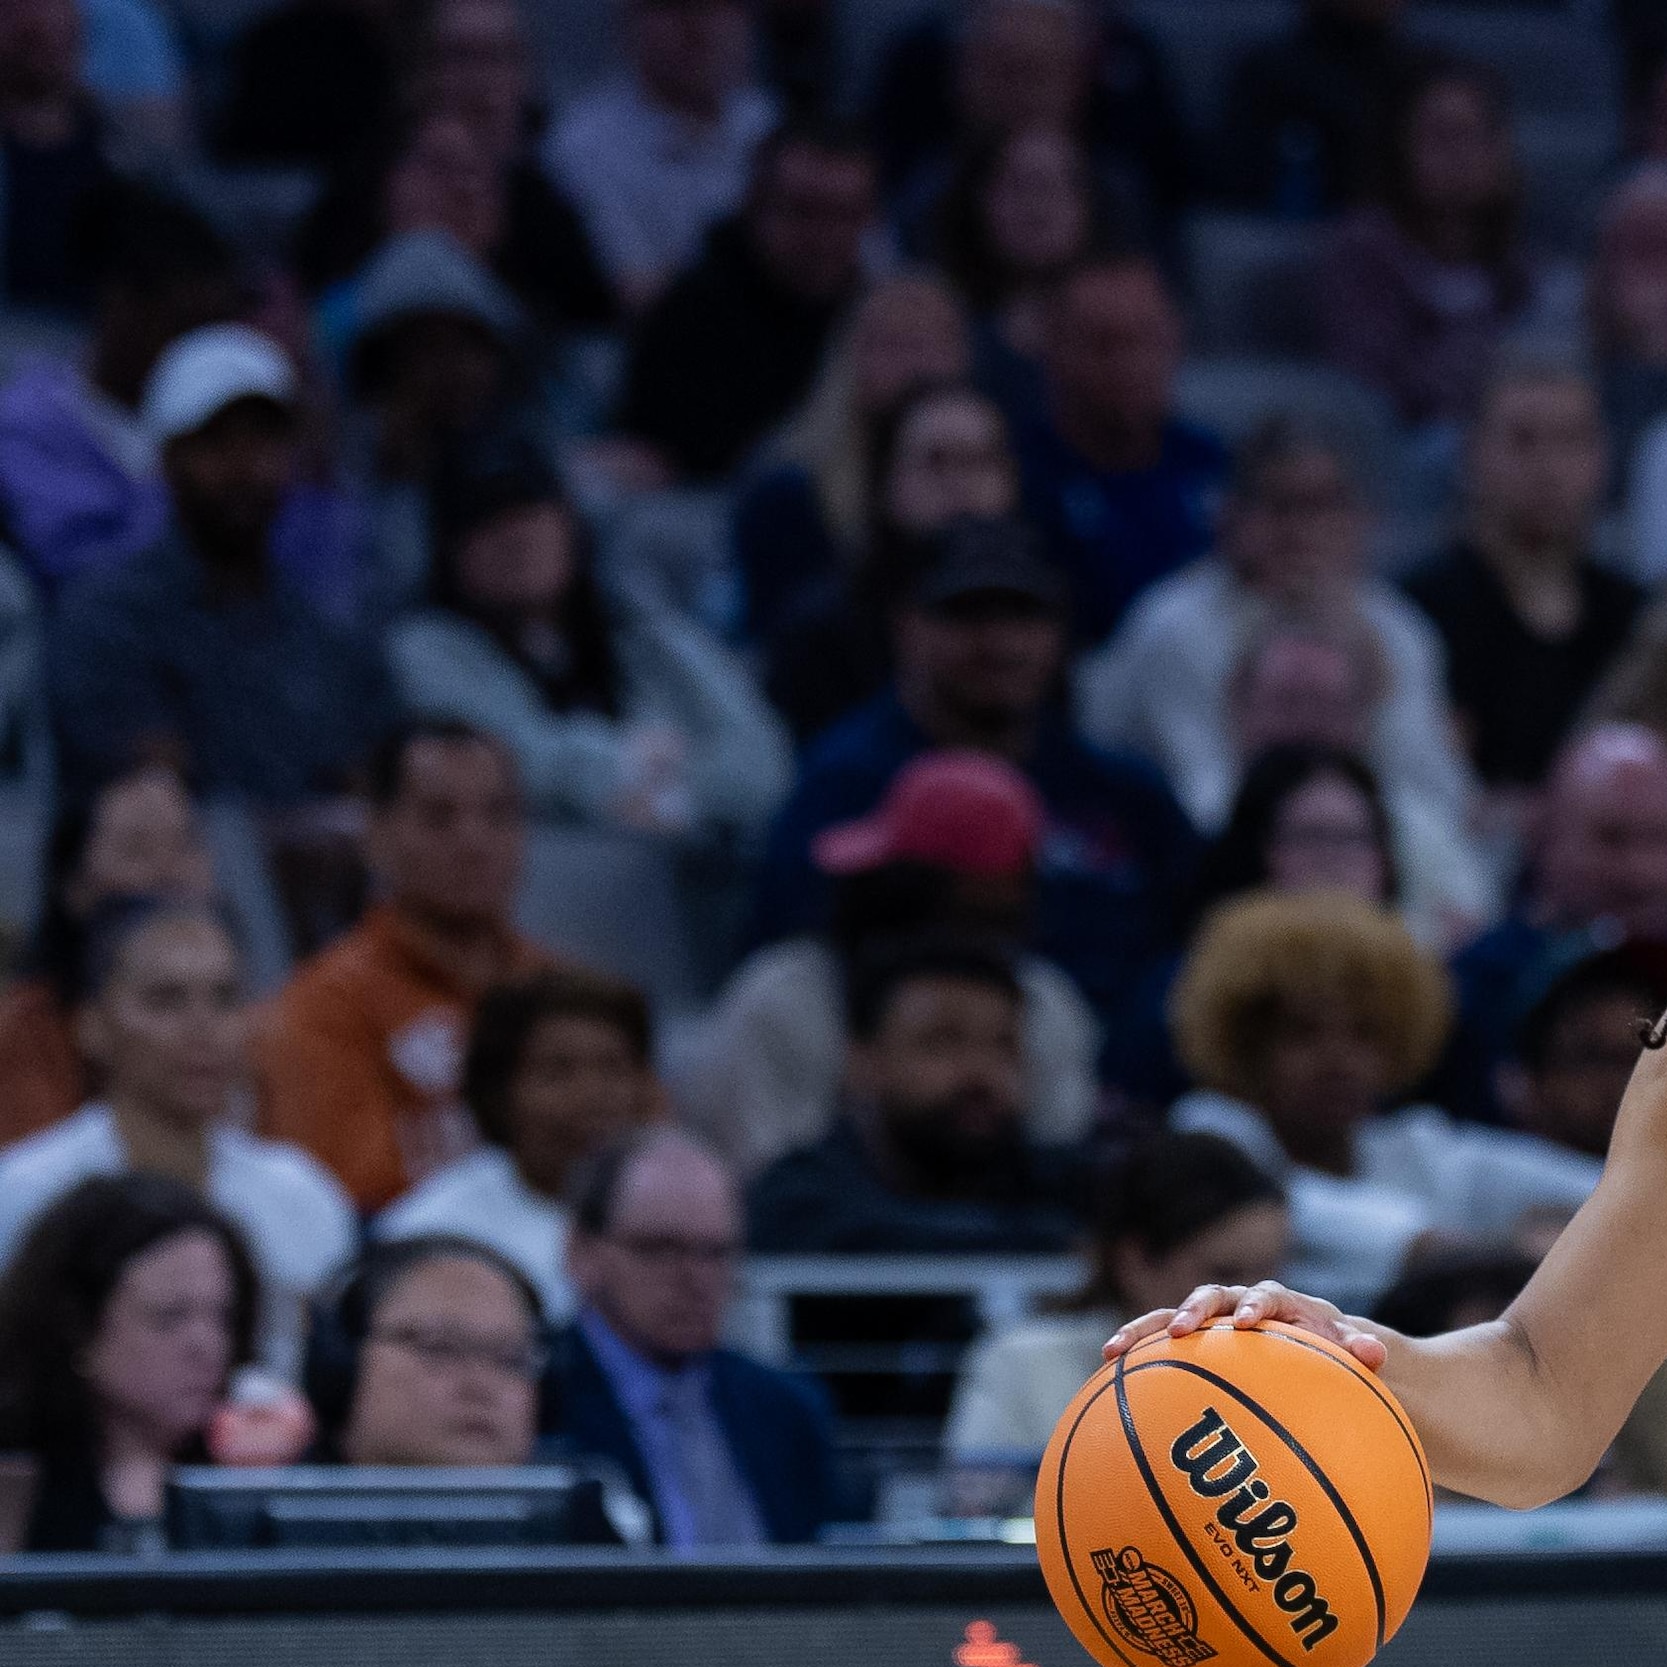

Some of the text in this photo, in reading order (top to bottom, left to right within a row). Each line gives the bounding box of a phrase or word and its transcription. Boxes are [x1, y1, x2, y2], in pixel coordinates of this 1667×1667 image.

[1169, 1406, 1340, 1653] Wilson
[1203, 1521, 1260, 1593] EVO NXT
[1116, 1587, 1194, 1667] MADNESS
[1127, 1570, 1187, 1636] MARCH
